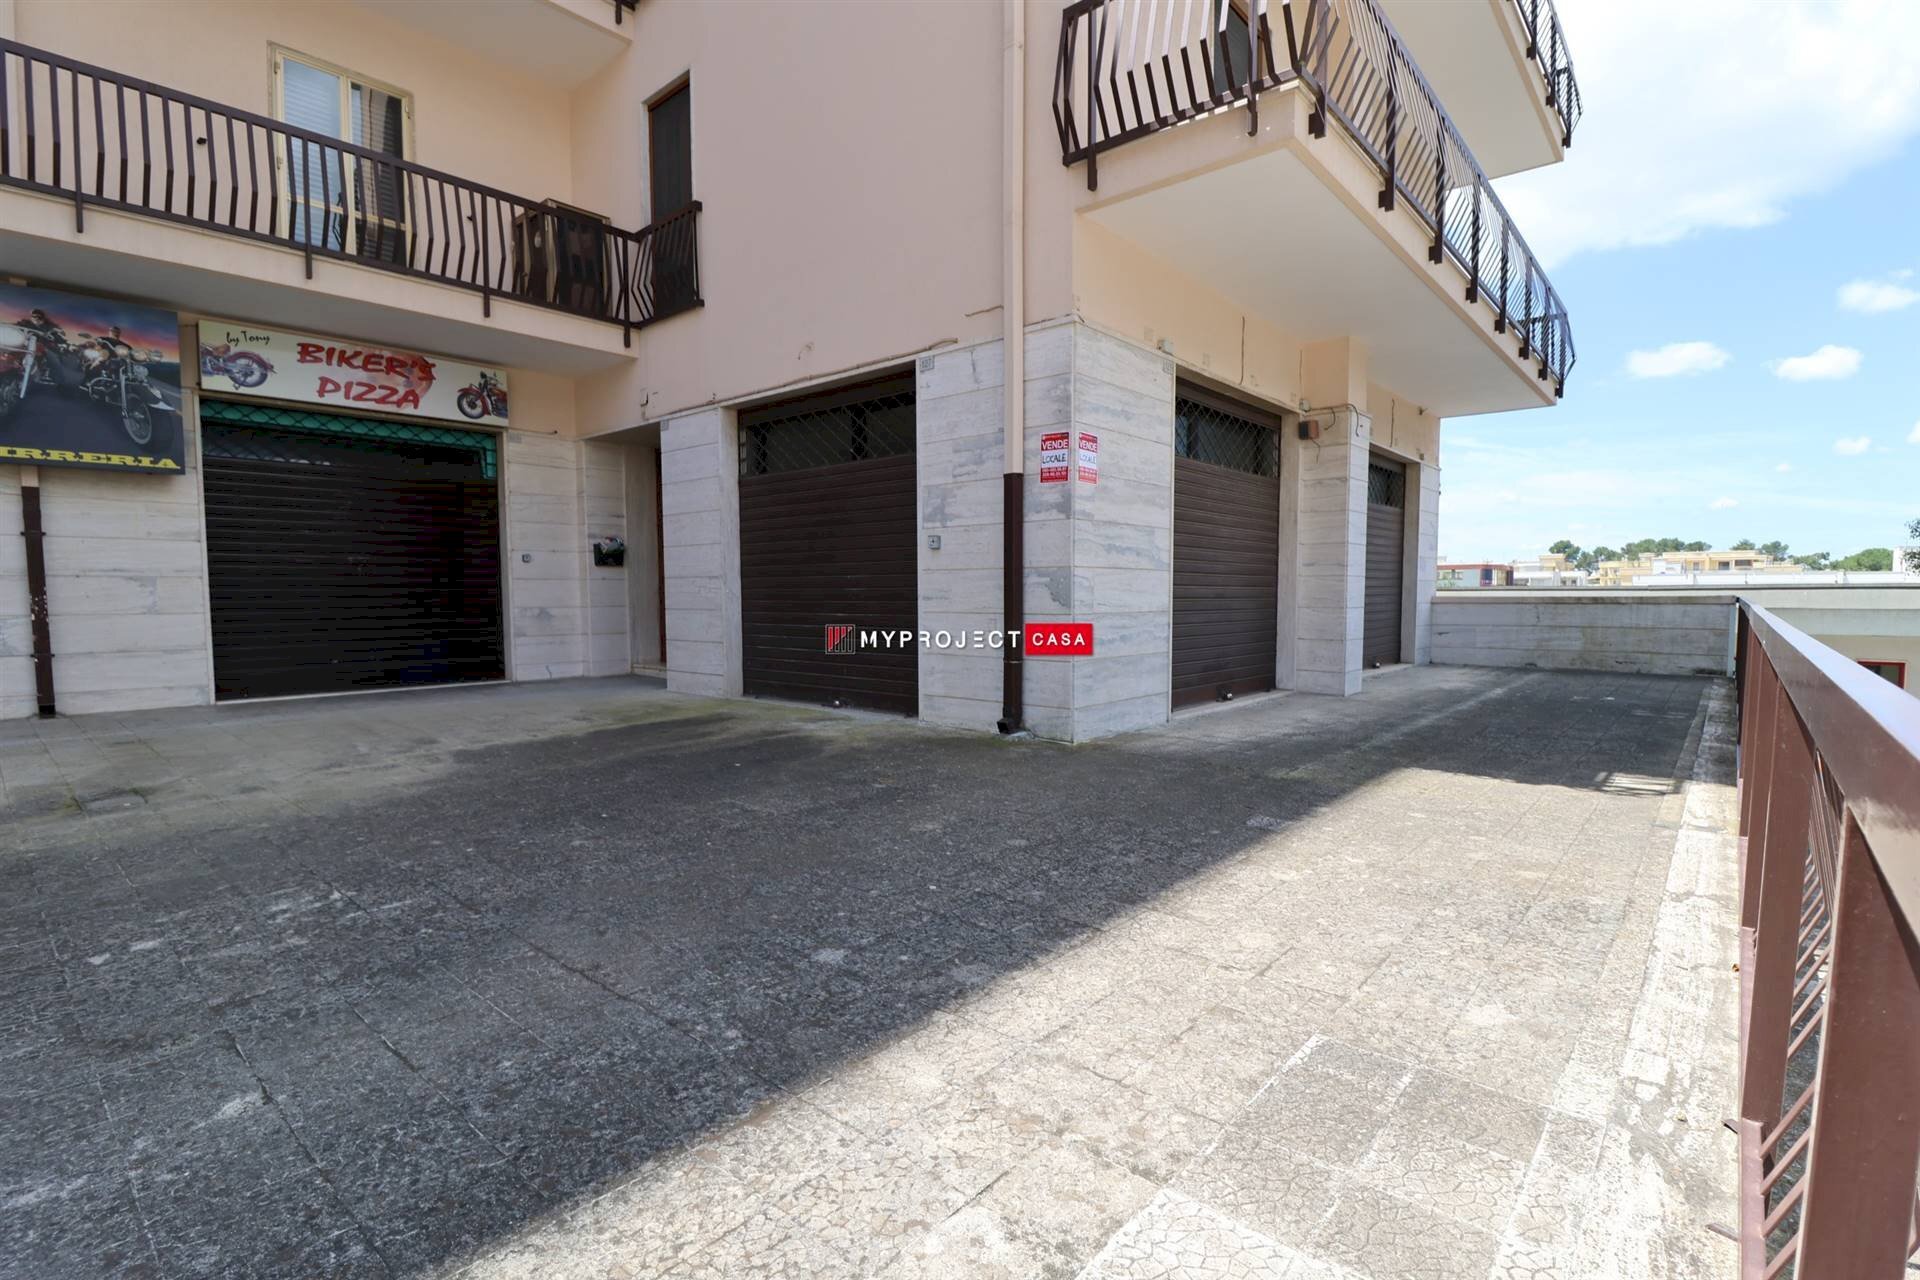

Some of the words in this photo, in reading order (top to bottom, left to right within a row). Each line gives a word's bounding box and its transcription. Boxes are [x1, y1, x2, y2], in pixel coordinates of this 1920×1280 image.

[226, 331, 240, 347] by
[240, 330, 270, 346] Tony
[316, 376, 420, 410] PIZZA
[1041, 439, 1069, 450] VENDE
[1080, 439, 1097, 452] VENDE
[1042, 453, 1066, 464] LOCALE
